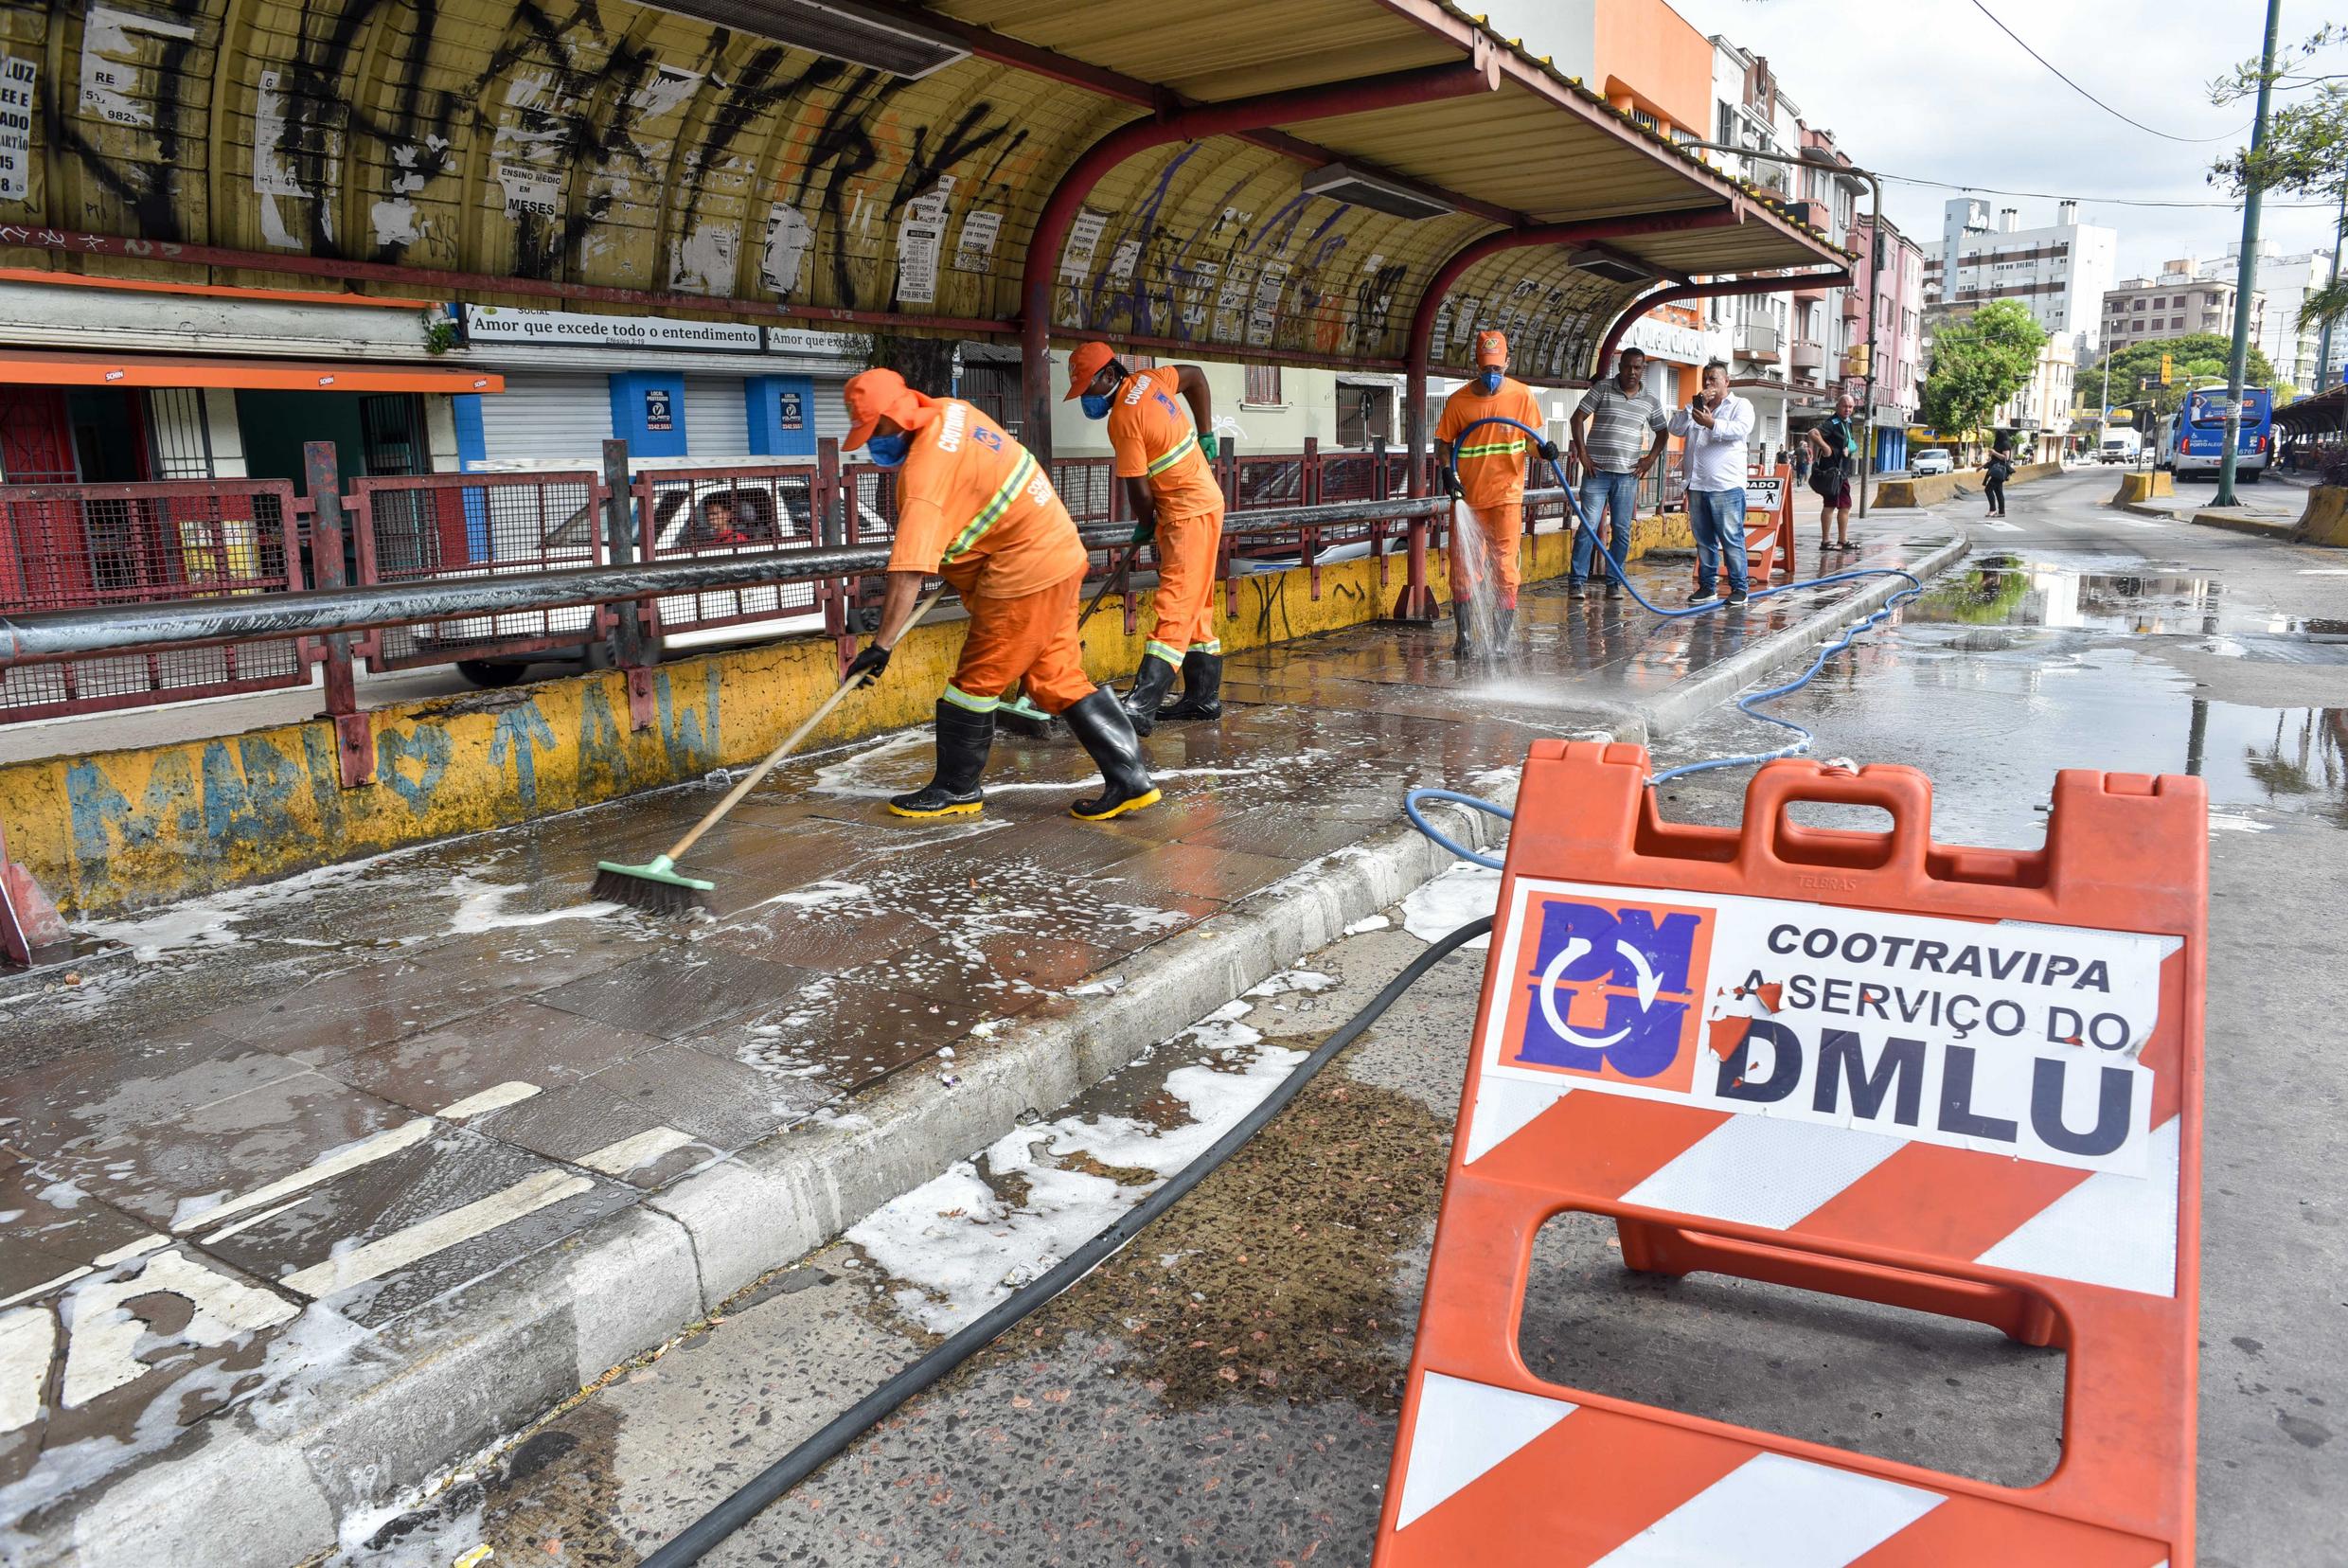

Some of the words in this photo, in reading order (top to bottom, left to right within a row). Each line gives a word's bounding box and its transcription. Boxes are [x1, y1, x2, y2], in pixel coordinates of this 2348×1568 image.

[502, 168, 533, 181] ENSINO
[535, 172, 561, 185] MÉDIO
[508, 198, 555, 215] MESES
[474, 317, 519, 332] Amor
[525, 322, 553, 336] que
[557, 323, 608, 335] excede
[613, 324, 646, 337] todo
[649, 328, 658, 337] o
[662, 328, 756, 343] entendimento
[773, 332, 803, 345] Amor
[806, 335, 825, 348] que
[1798, 874, 1857, 893] TELBRAS
[1767, 923, 2111, 994] COOTRAVIPA
[1788, 973, 2026, 1040] SERVIÇO
[2046, 1007, 2131, 1051] DO
[1716, 1016, 2134, 1157] DMLU
